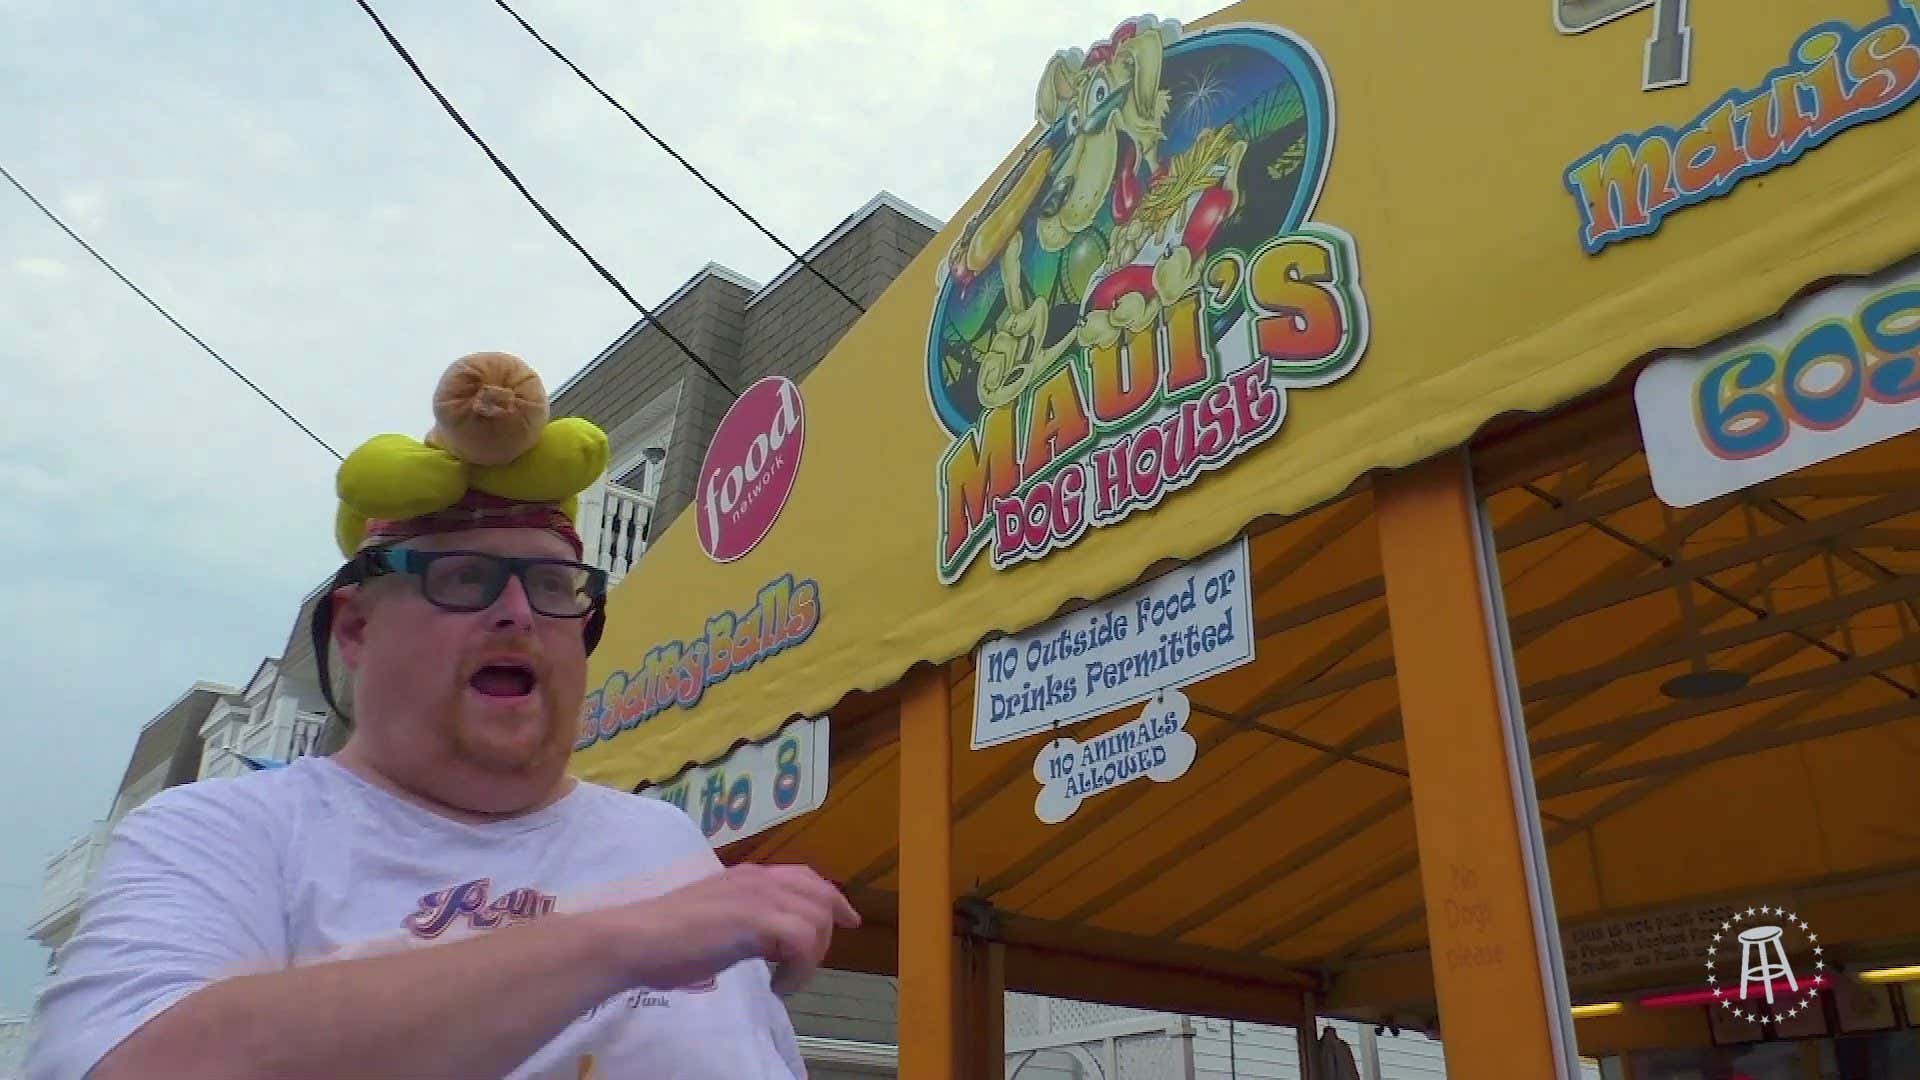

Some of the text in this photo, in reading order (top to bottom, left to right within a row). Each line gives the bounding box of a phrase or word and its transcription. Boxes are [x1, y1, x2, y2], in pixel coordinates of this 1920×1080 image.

[945, 238, 1343, 565] MAUI'S
[704, 380, 800, 558] food
[732, 455, 785, 525] network
[995, 358, 1276, 555] DOG HOUSE
[989, 606, 1235, 723] Drinks Permitted
[1025, 610, 1129, 672] Outside
[1135, 575, 1196, 636] Food
[1204, 568, 1236, 605] or
[701, 768, 752, 838] to
[773, 735, 800, 810] 8
[1063, 744, 1168, 800] ALLOWED
[1081, 710, 1179, 768] ANIMALS
